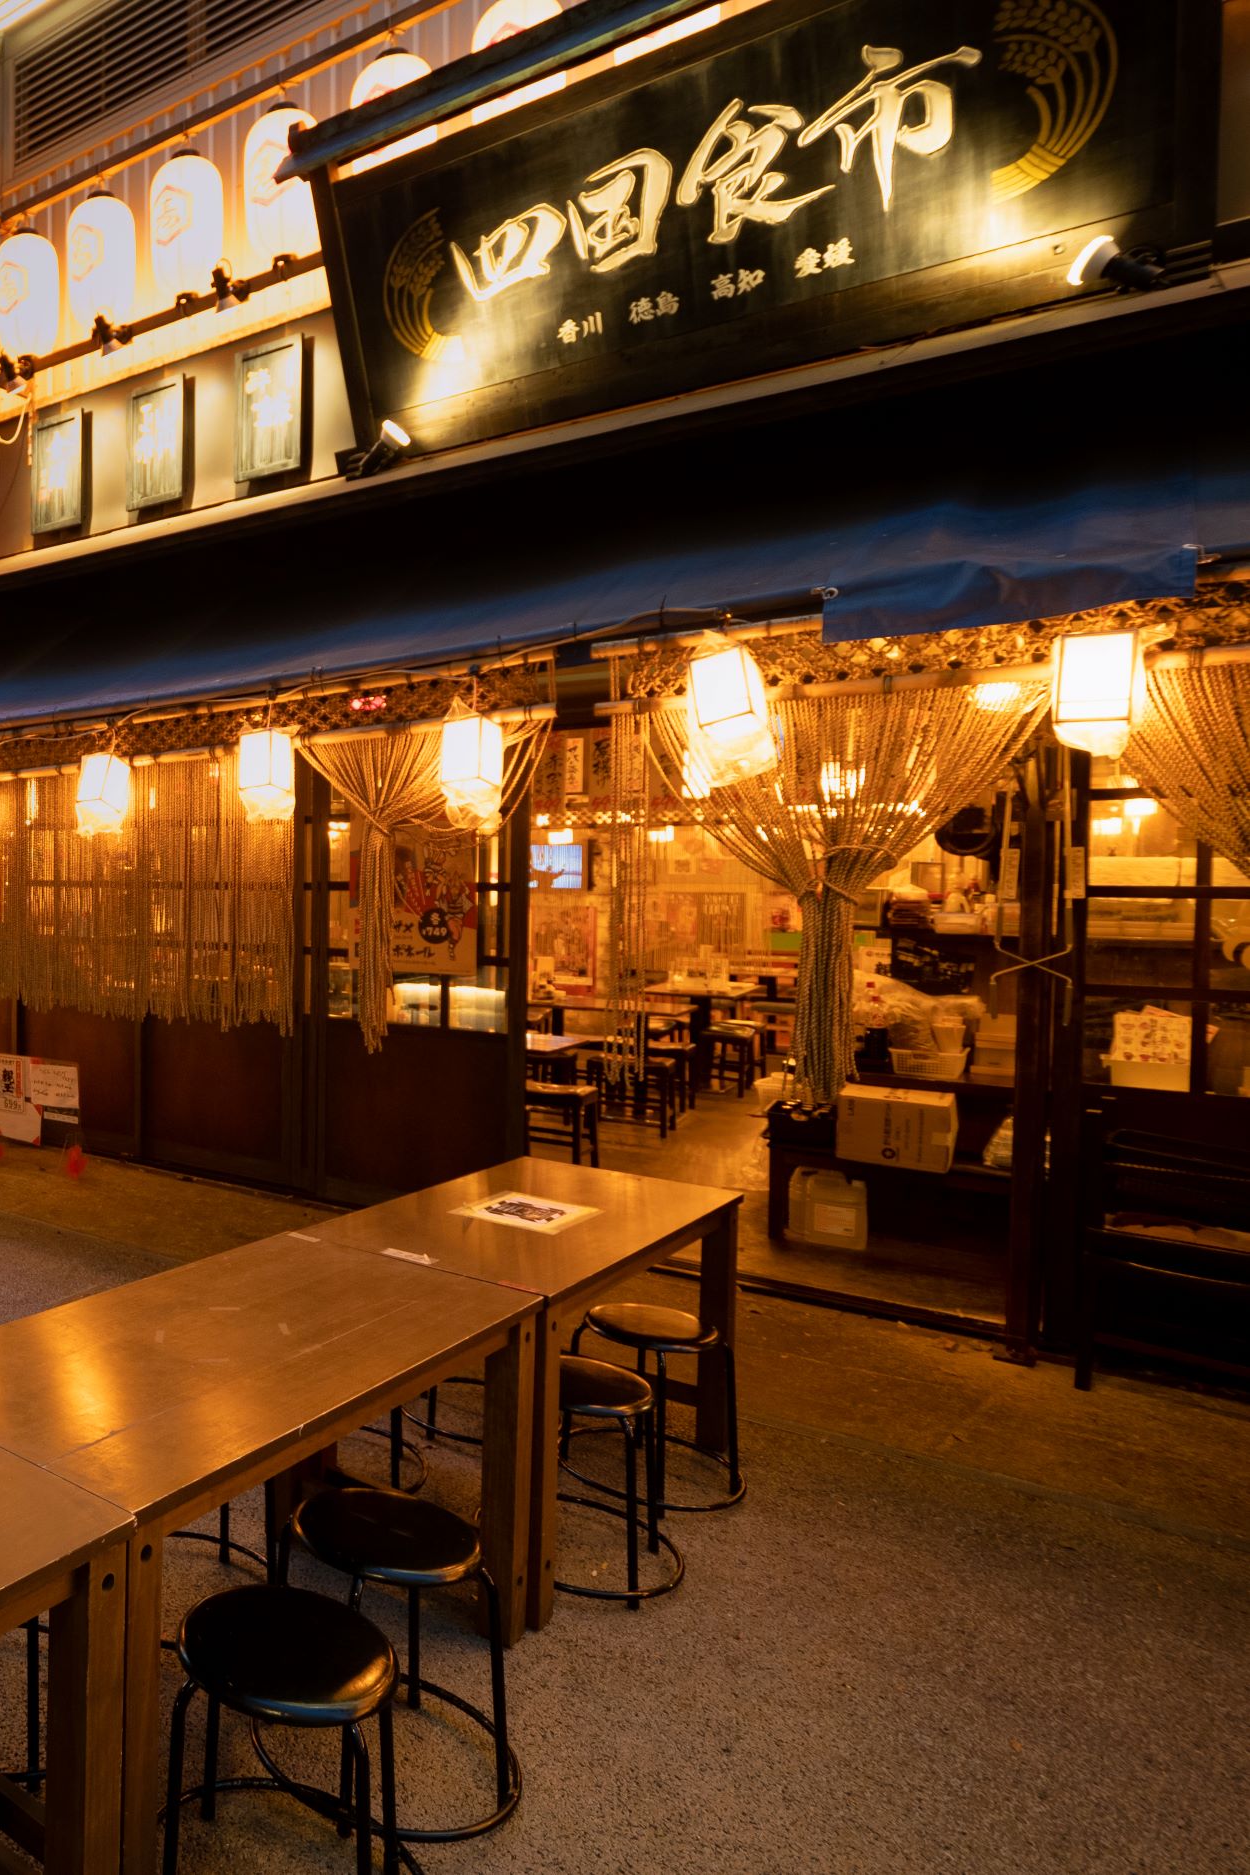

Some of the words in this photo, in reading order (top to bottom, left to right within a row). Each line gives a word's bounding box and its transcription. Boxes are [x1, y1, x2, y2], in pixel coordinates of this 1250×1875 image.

[448, 44, 981, 302] 四国食市
[556, 310, 605, 346] 香川
[627, 289, 680, 326] 徳島
[710, 267, 766, 303] 高知
[793, 235, 856, 279] 愛媛
